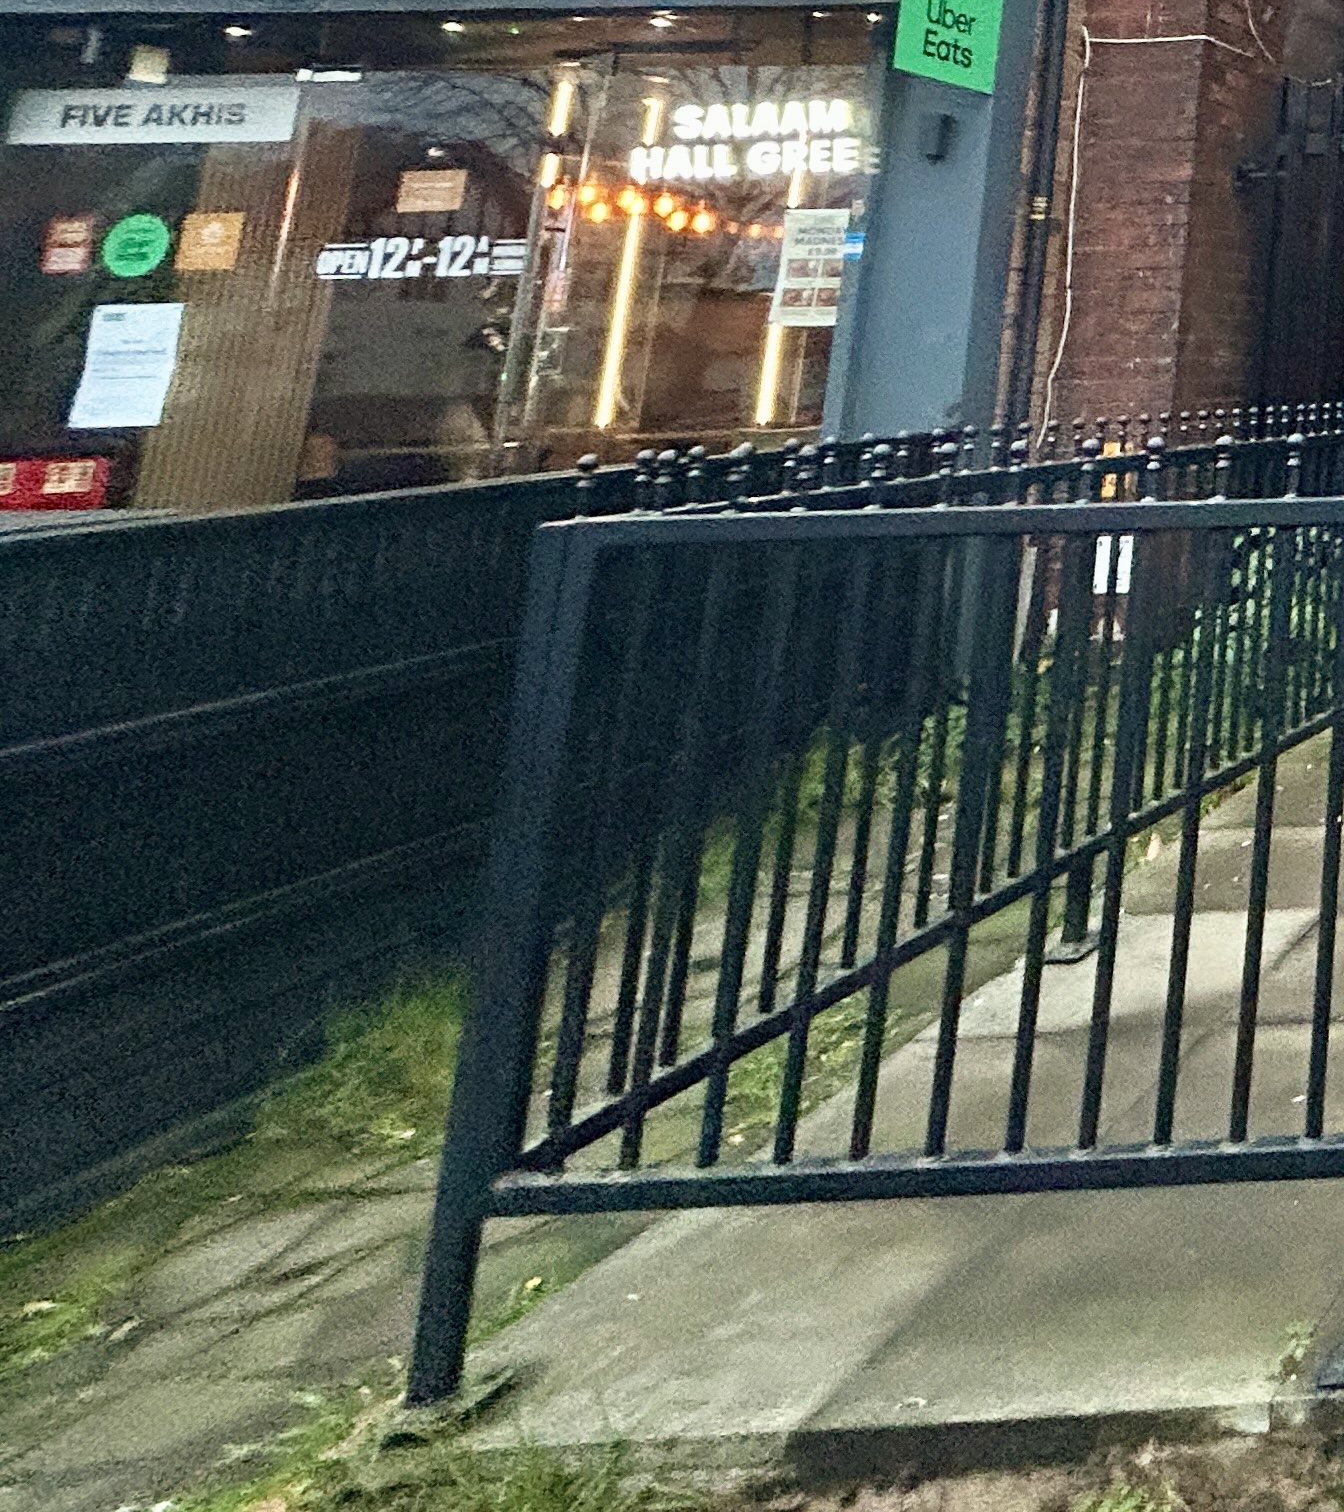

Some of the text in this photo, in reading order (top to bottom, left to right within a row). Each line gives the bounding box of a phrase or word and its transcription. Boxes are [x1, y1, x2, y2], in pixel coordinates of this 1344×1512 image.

[923, 28, 973, 68] Eats
[61, 103, 246, 128] FIVE AKHIS
[672, 98, 851, 140] SALAAM
[630, 144, 738, 181] HALL
